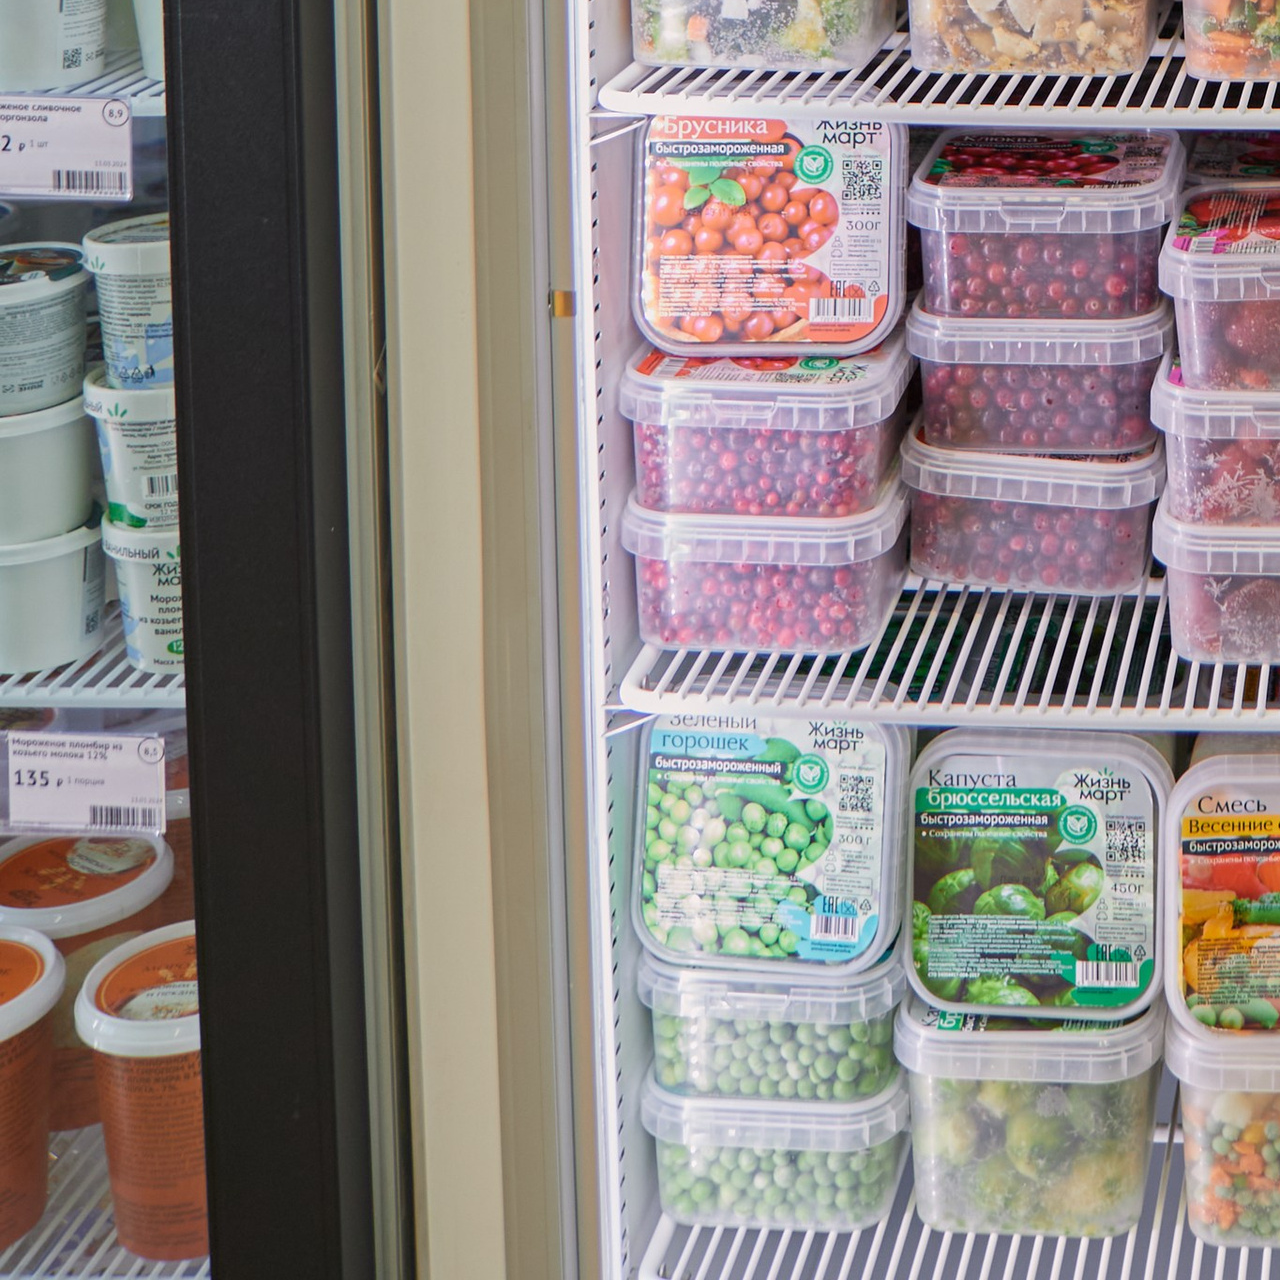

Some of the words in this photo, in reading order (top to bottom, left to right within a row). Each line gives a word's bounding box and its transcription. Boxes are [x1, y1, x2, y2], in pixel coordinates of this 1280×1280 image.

[108, 109, 123, 119] 8,9
[663, 116, 768, 139] Брусника
[822, 130, 877, 149] март
[655, 143, 784, 155] быстрозамороженная
[846, 220, 881, 231] 300г
[830, 281, 847, 297] EAC
[808, 721, 864, 739] Жизнь
[12, 737, 67, 748] Мороженое
[69, 741, 110, 751] пломбир
[662, 734, 749, 754] горошек
[813, 738, 859, 754] март
[12, 750, 48, 758] козьего
[50, 751, 84, 759] молока
[88, 751, 108, 760] 12%
[655, 756, 781, 773] быстрозамороженный
[14, 769, 50, 787] 135
[74, 777, 105, 786] порция
[929, 769, 1017, 791] Капуста
[1074, 772, 1131, 789] Жизнь
[928, 789, 1061, 809] брюссельская
[1079, 788, 1126, 805] март
[1197, 795, 1267, 814] Смесь
[921, 813, 1048, 826] быстрозамороженная
[1189, 819, 1273, 834] Весенние
[1111, 883, 1144, 894] 450г
[822, 896, 839, 914] EAC
[1096, 944, 1113, 961] EAC
